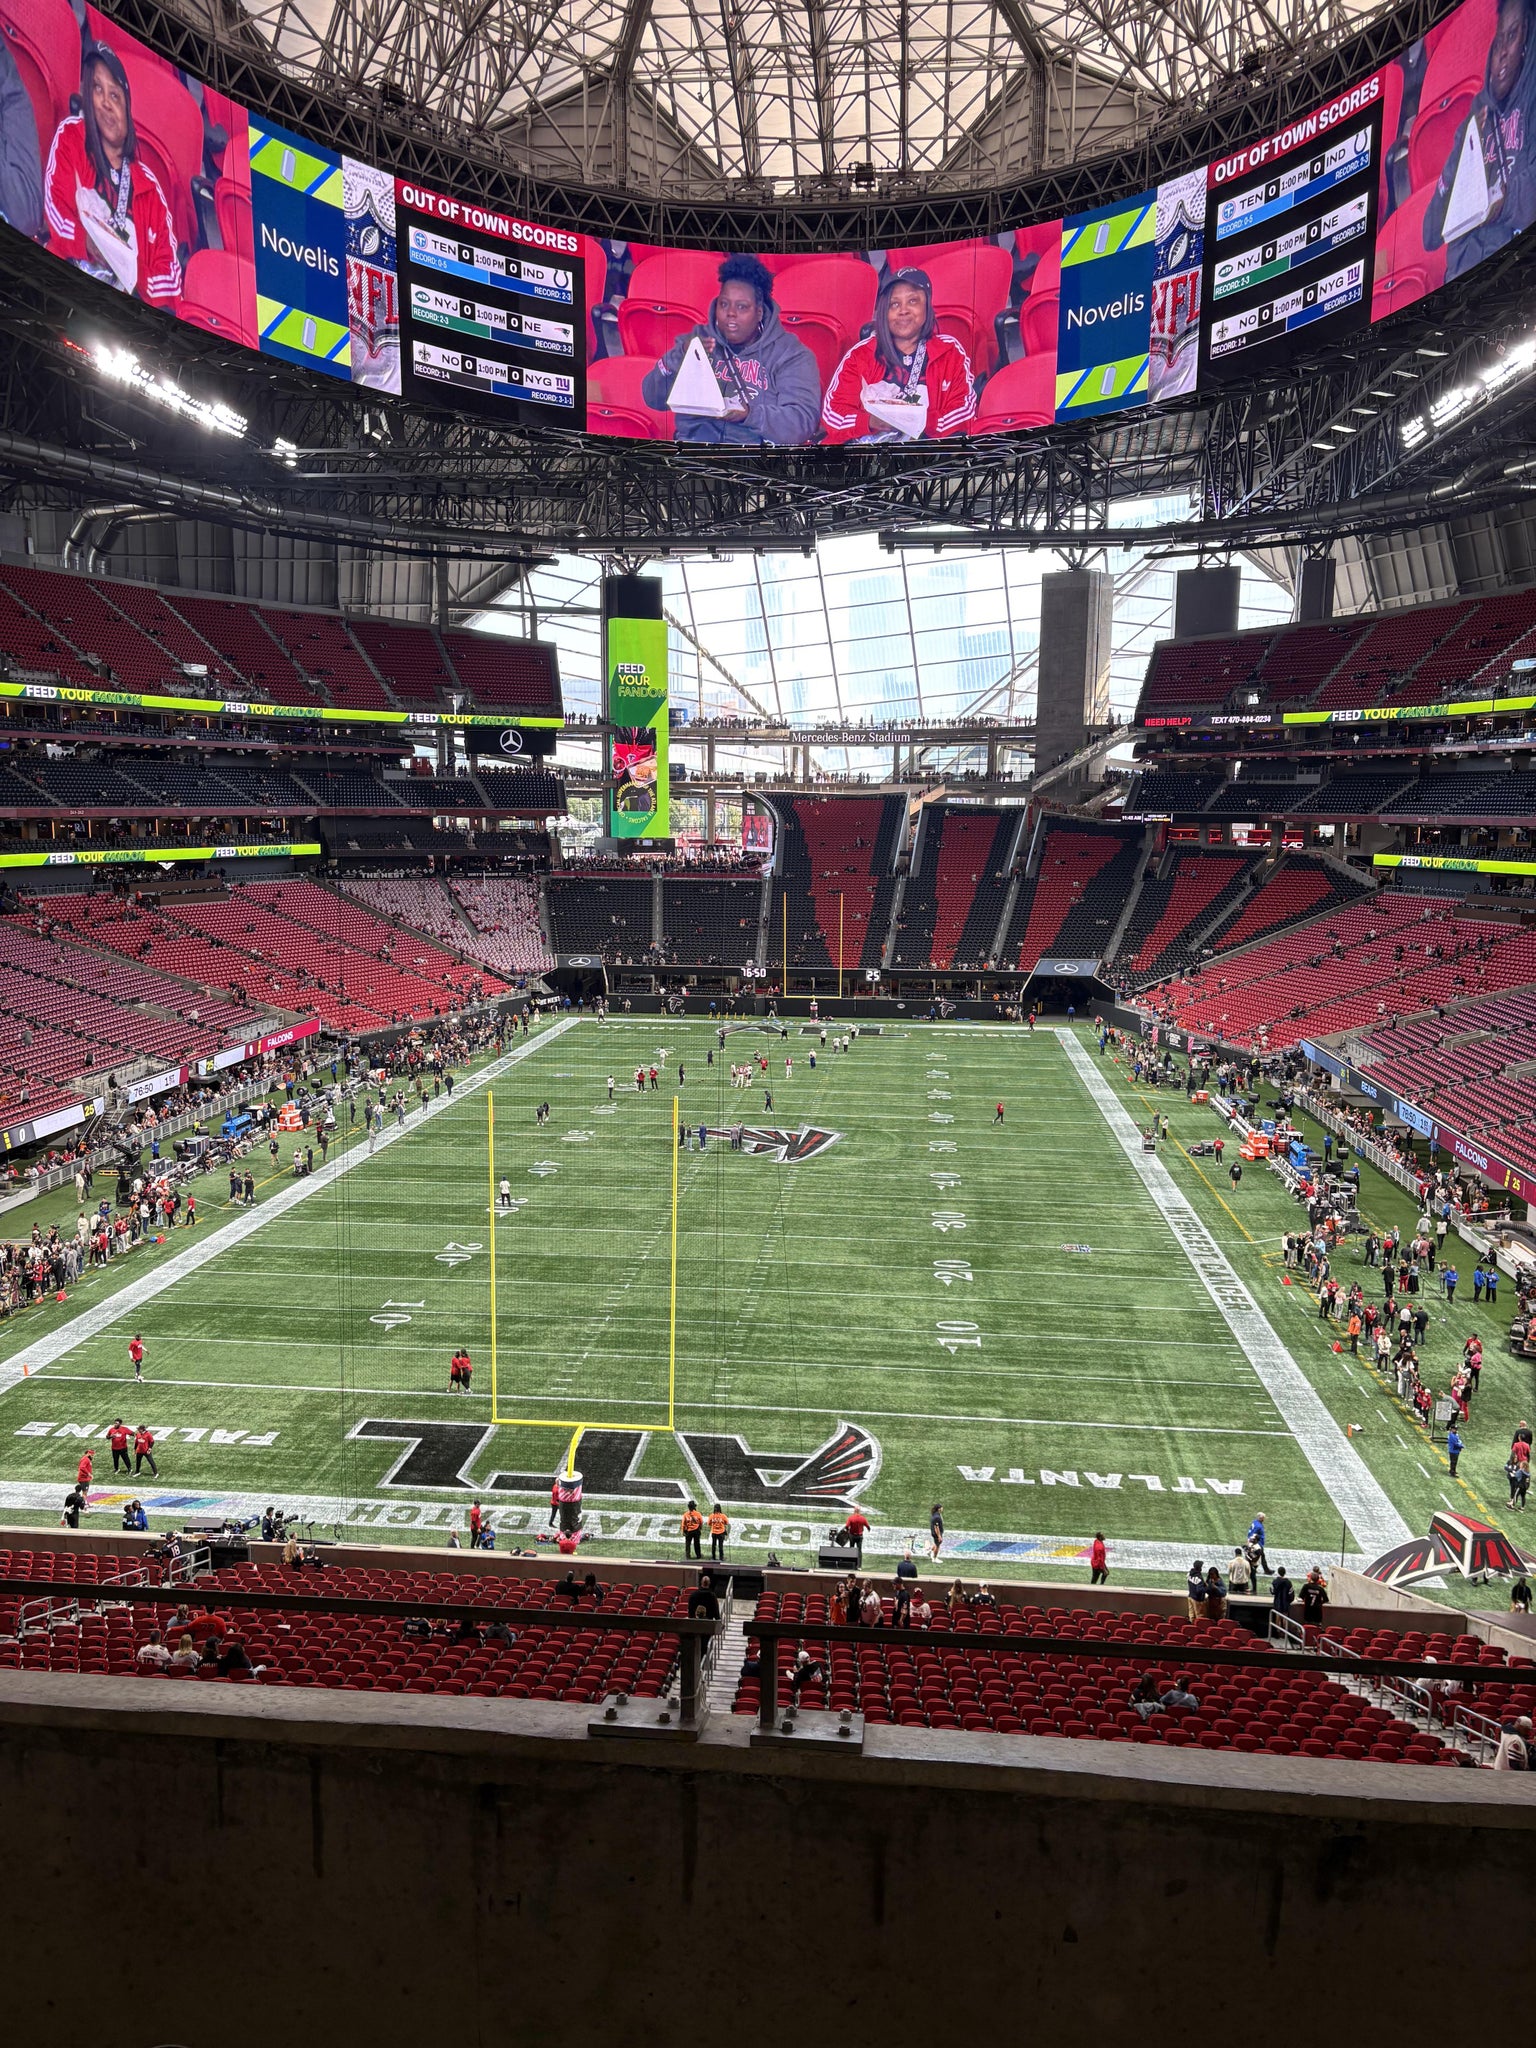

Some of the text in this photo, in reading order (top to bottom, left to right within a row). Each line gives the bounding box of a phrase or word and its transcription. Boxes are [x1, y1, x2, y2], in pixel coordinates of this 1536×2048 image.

[1215, 76, 1380, 182] OUT OF TOWN SCORES
[1335, 160, 1360, 181] RECORD:
[1240, 148, 1346, 210] TEN 0 1:00 PM 0 IND
[403, 186, 577, 252] OUT OF TOWN SCORES
[1218, 220, 1244, 235] RECORD:
[1237, 215, 1339, 271] NYJ 0 1:00 PM 0 NE
[1331, 226, 1357, 245] RECORD:
[261, 222, 340, 278] Novelis
[411, 251, 437, 267] RECORD:
[432, 239, 544, 280] TEN 0 1:00 PM 0 IND
[346, 259, 399, 327] NFL
[534, 286, 561, 299] RECORD:
[1215, 280, 1241, 295] RECORD:
[1151, 270, 1201, 335] NFL
[1239, 276, 1344, 330] NO 0 1:00 PM 0 NYG
[1324, 294, 1349, 312] RECORD:
[413, 308, 439, 322] RECORD:
[434, 297, 541, 333] NYJ 0 1:00 PM 0 NE
[1067, 291, 1145, 330] Novelis
[536, 340, 562, 351] RECORD:
[1212, 340, 1237, 355] RECORD:
[415, 365, 441, 378] RECORD:
[442, 354, 552, 387] NO 0 1:00 PM 0 NYG
[532, 392, 558, 403] RECORD:
[618, 663, 646, 674] FEED
[619, 675, 650, 686] YOUR
[25, 685, 57, 698] FEED
[59, 688, 93, 702] YOUR
[618, 686, 667, 698] FANDOM
[225, 702, 248, 713] FEED
[249, 704, 275, 716] YOUR
[1332, 710, 1361, 721] FEED
[1363, 708, 1398, 720] YOUR
[409, 713, 438, 723] FEED
[441, 714, 472, 724] YOUR
[1145, 717, 1192, 727] NEED HELP?
[1211, 716, 1228, 724] TEXT
[792, 732, 910, 743] Mercedes-Benz Stadium
[49, 853, 75, 863] FEED
[78, 852, 105, 862] YOUR
[216, 847, 236, 857] FEED
[237, 847, 259, 856] YOUR
[1402, 856, 1420, 866] FEED
[1420, 857, 1444, 869] YOUR
[741, 968, 766, 978] 76:50
[867, 971, 879, 980] 25
[267, 1031, 294, 1048] FALCONS
[206, 1060, 214, 1071] 25
[134, 1085, 154, 1097] 76:50
[1361, 1080, 1378, 1099] BEARS
[84, 1106, 95, 1117] 25
[19, 1129, 26, 1142] 0
[929, 1140, 958, 1152] 50
[1455, 1140, 1488, 1170] FALCONS
[929, 1172, 961, 1187] 40
[1512, 1177, 1521, 1191] 25
[931, 1211, 967, 1230] 30
[434, 1242, 484, 1263] 20
[1164, 1206, 1254, 1311] INTERCEPT CANCER
[933, 1259, 973, 1281] 20
[369, 1299, 426, 1324] 10
[935, 1320, 982, 1348] 10
[345, 1419, 886, 1516] ATL
[956, 1465, 1247, 1496] ATLANTA
[575, 1514, 811, 1546] CRCIA
[171, 1545, 181, 1557] 18
[1310, 1594, 1317, 1606] 7
